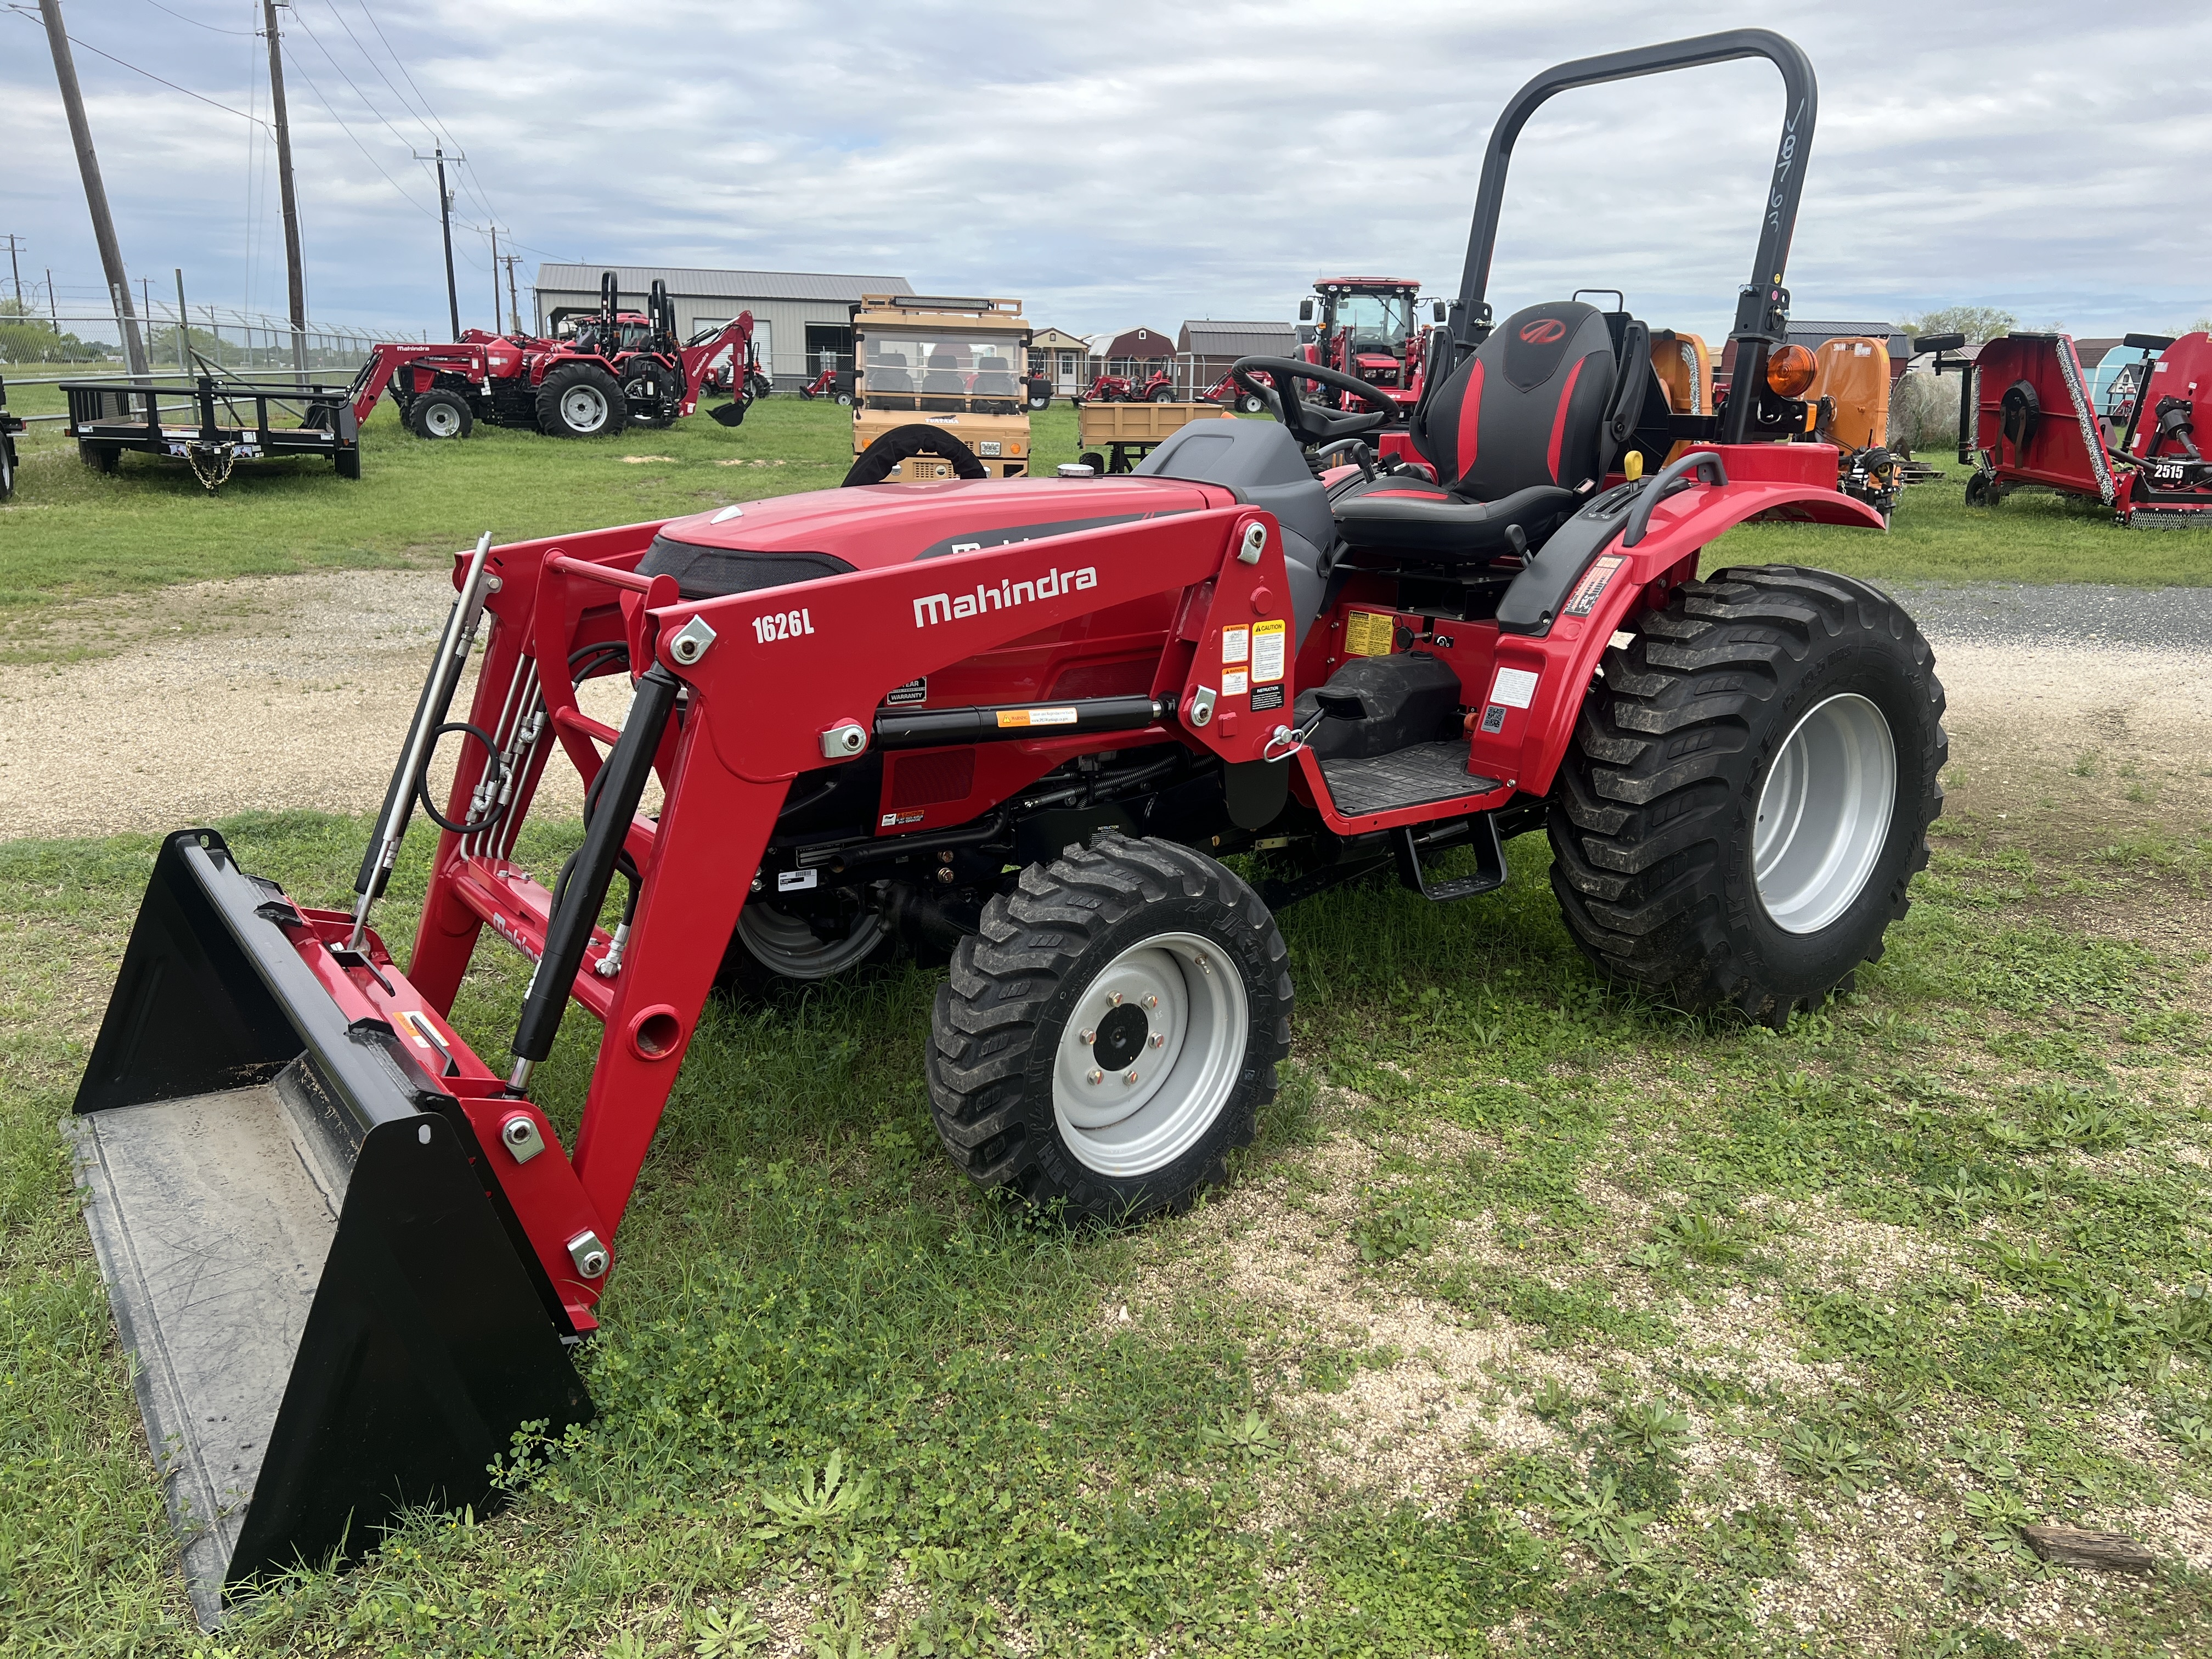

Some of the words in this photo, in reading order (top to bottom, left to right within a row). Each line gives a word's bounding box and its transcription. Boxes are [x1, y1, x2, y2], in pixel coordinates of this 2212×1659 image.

[2154, 464, 2183, 478] 2515
[913, 567, 1097, 628] Mahindra
[752, 608, 815, 644] 1626L
[493, 911, 543, 965] Mahind
